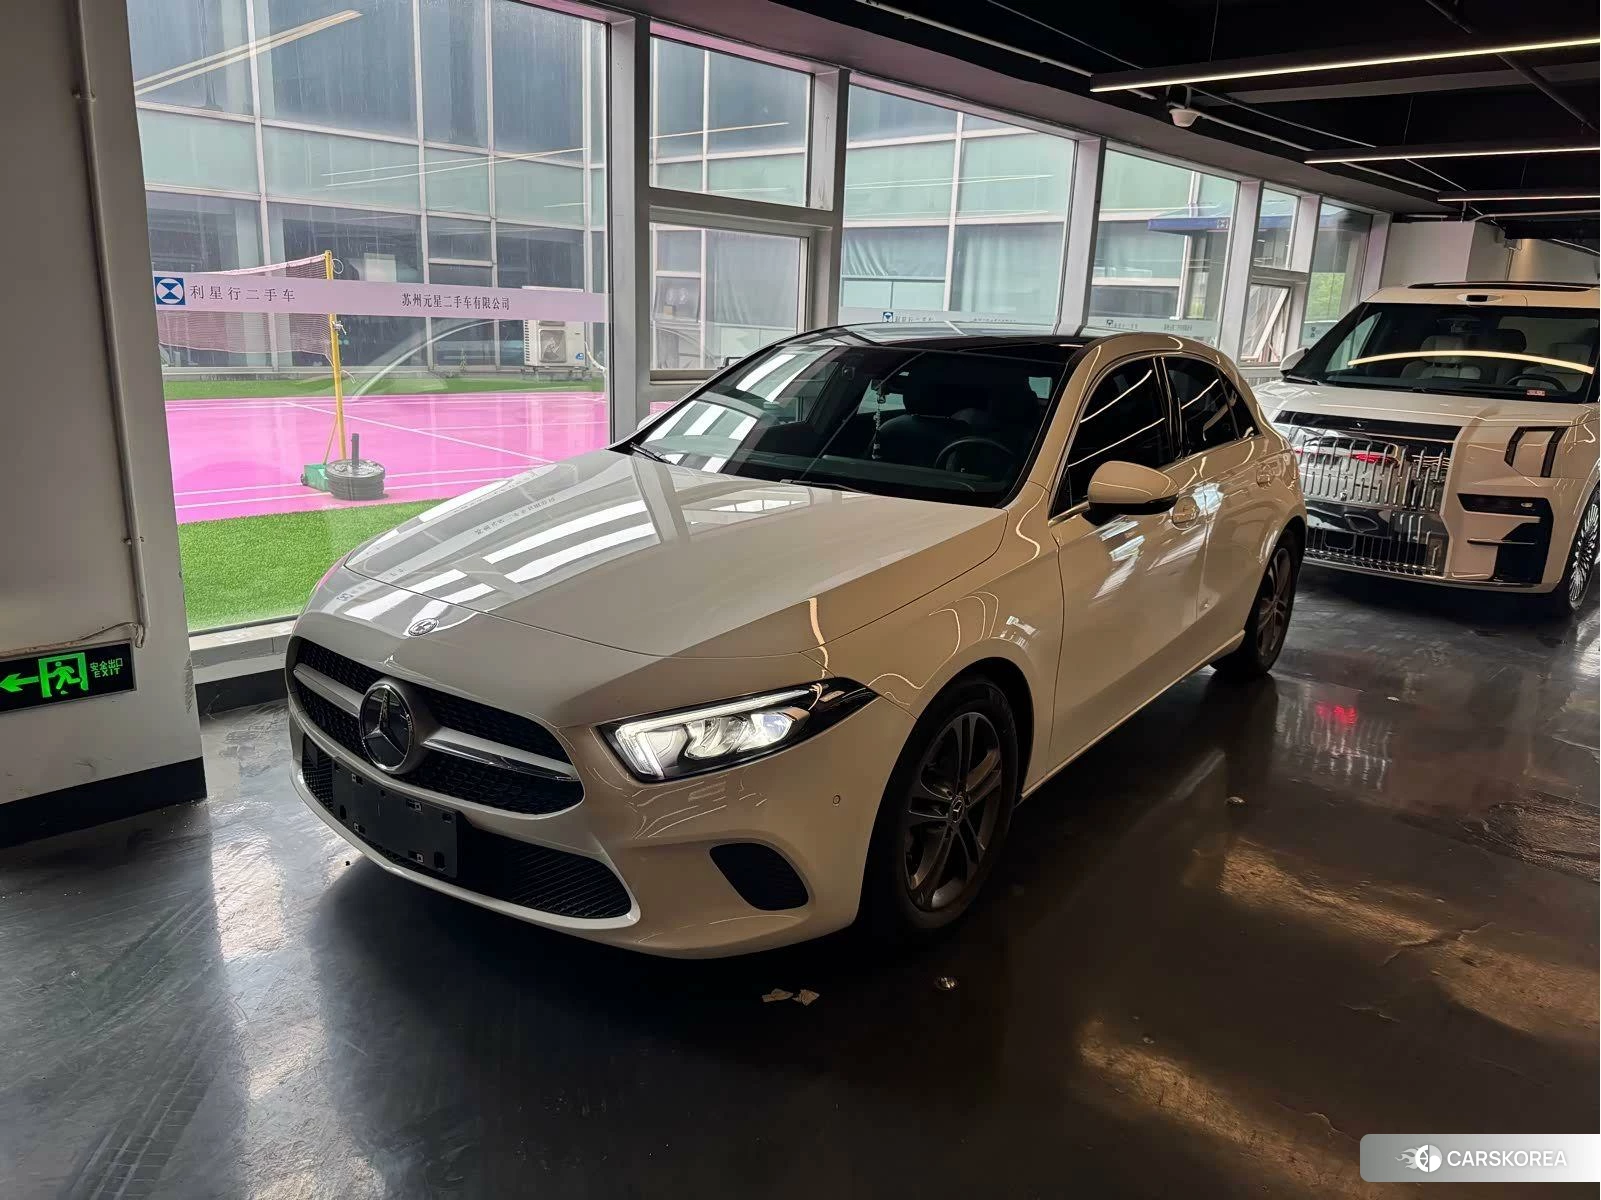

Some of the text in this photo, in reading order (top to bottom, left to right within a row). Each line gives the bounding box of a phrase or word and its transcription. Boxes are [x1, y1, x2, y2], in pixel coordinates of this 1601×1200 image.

[190, 285, 295, 302] 利星行二手车
[402, 293, 510, 311] 苏州元星二手车有限公司
[90, 657, 123, 672] 安全出口
[94, 667, 120, 679] EXIT
